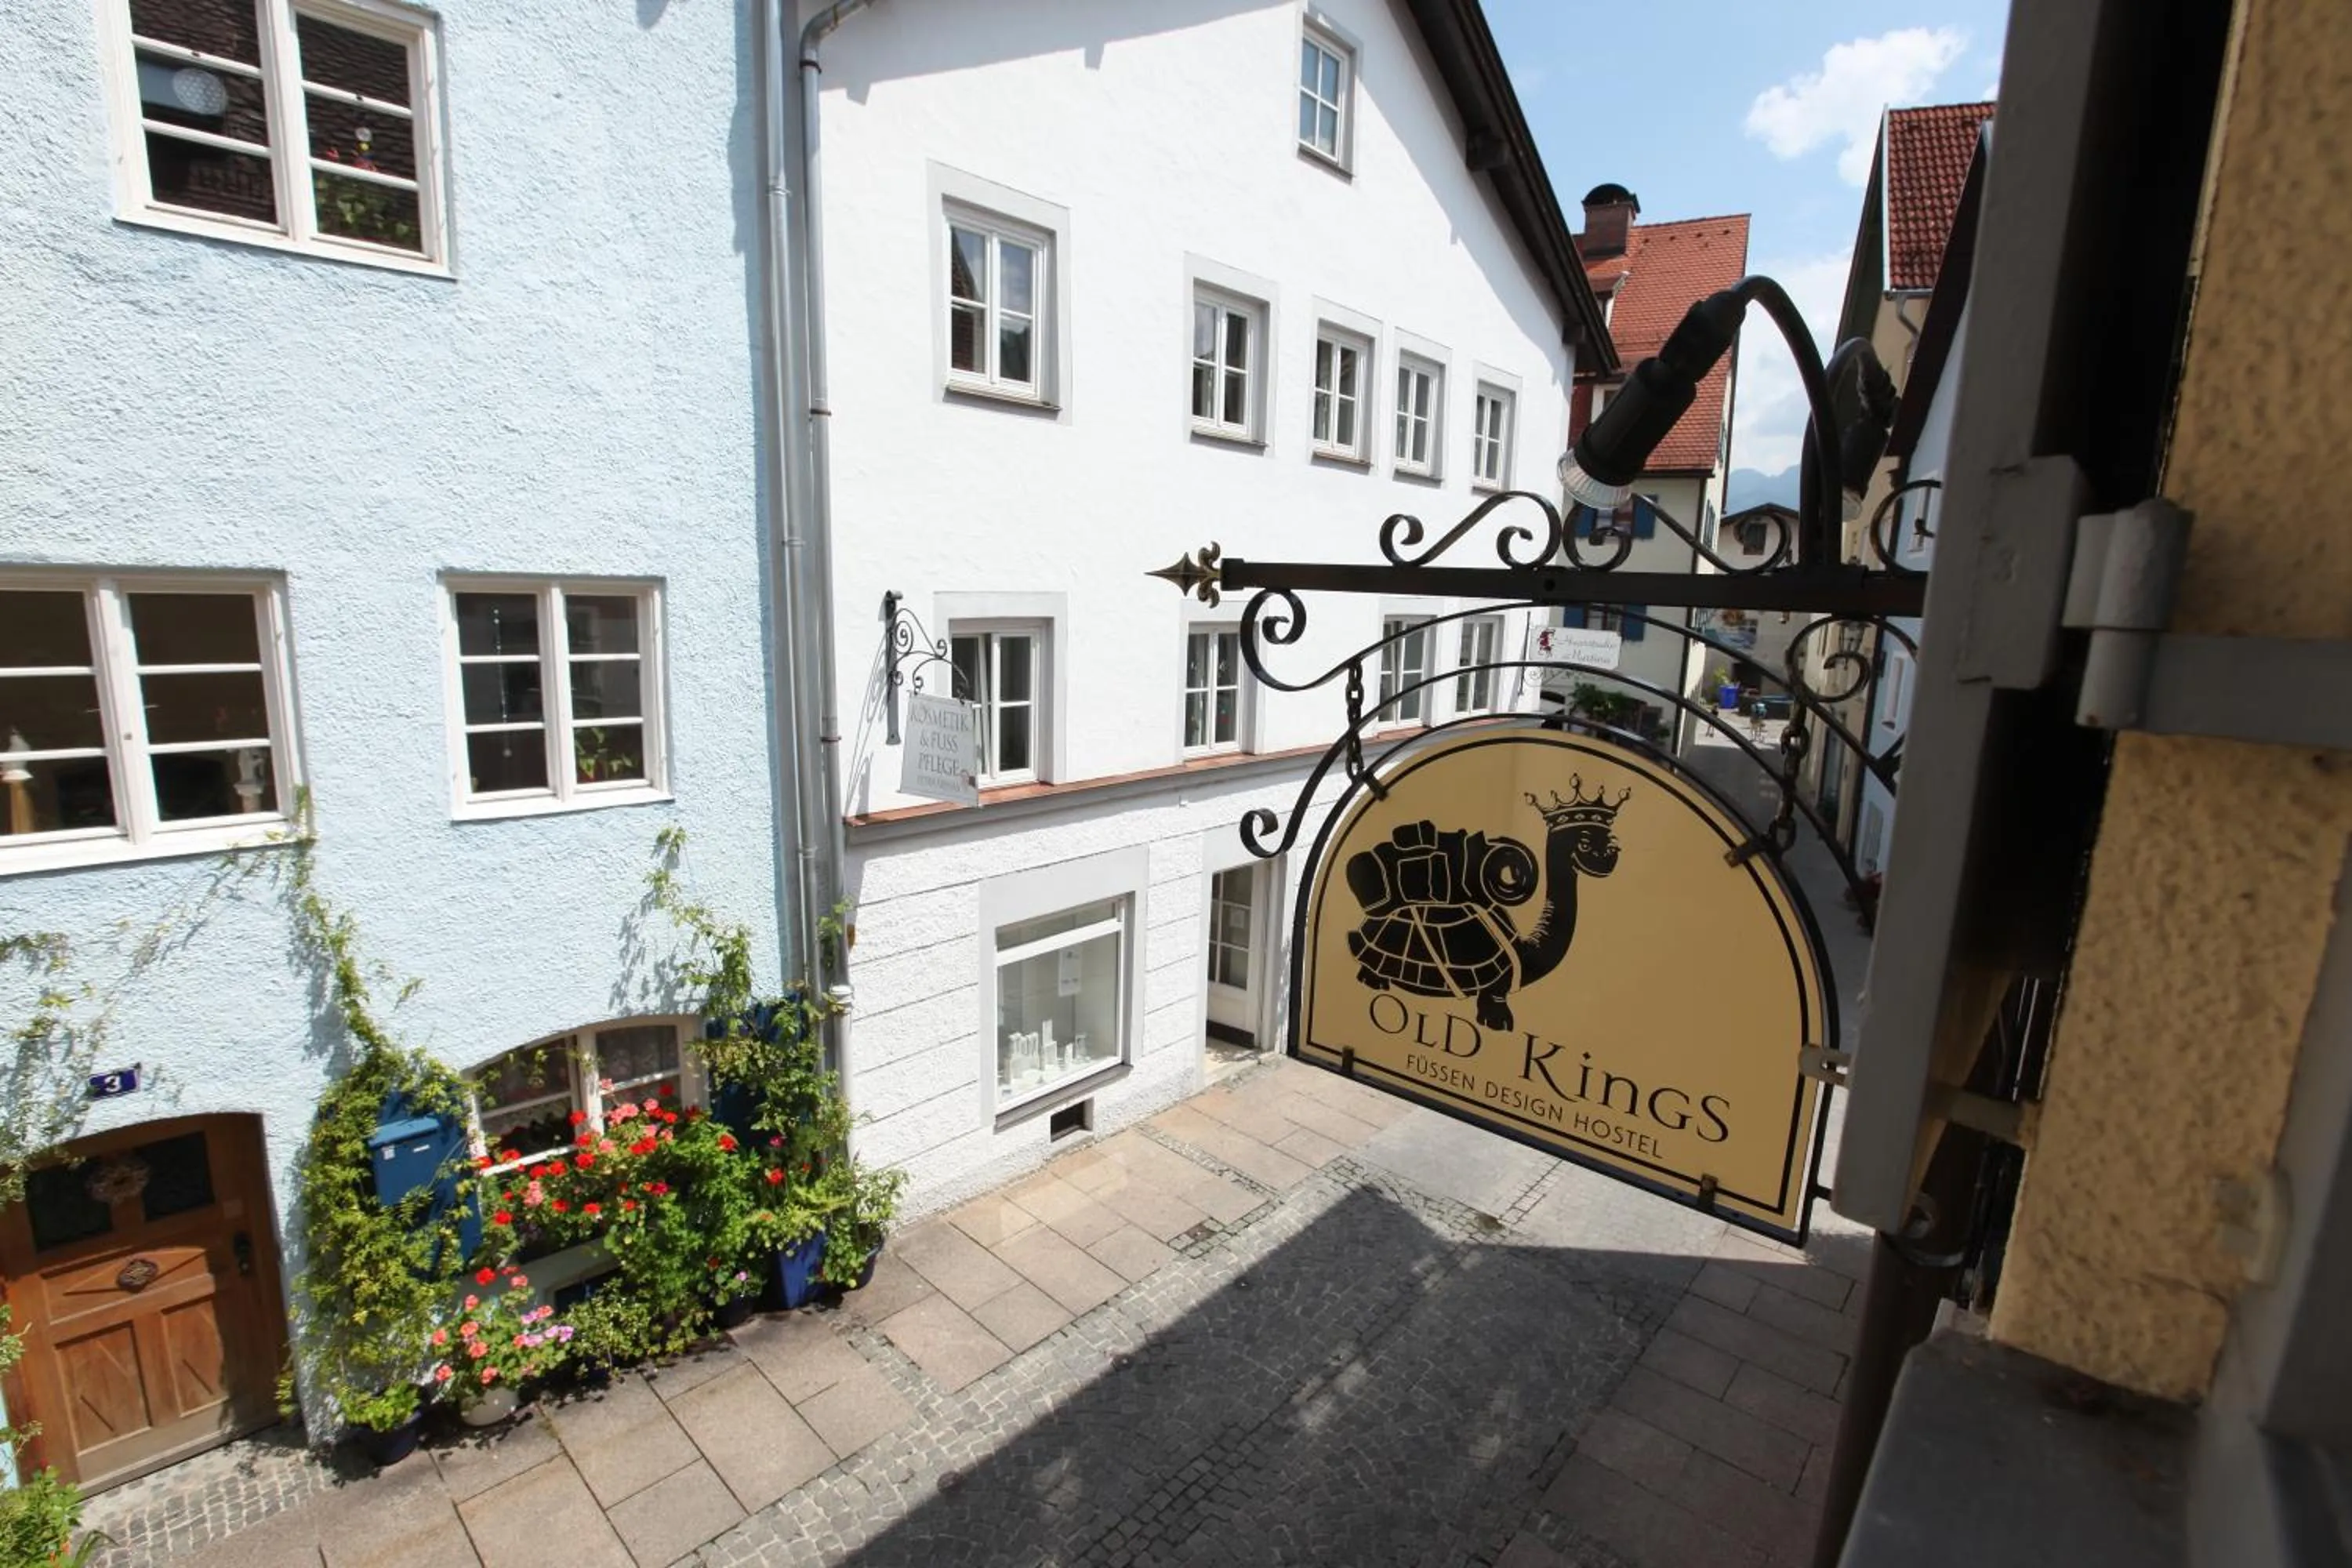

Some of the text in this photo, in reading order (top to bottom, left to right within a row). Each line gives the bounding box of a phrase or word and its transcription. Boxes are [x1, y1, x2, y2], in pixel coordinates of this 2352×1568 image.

[910, 705, 969, 731] KOSMETIK
[931, 731, 959, 753] FUSS
[917, 753, 960, 776] PFLEGE
[1370, 993, 1481, 1058] OLD
[103, 1075, 122, 1093] 3
[1406, 1053, 1664, 1159] FÜSSEN DESIGN HOSTEL
